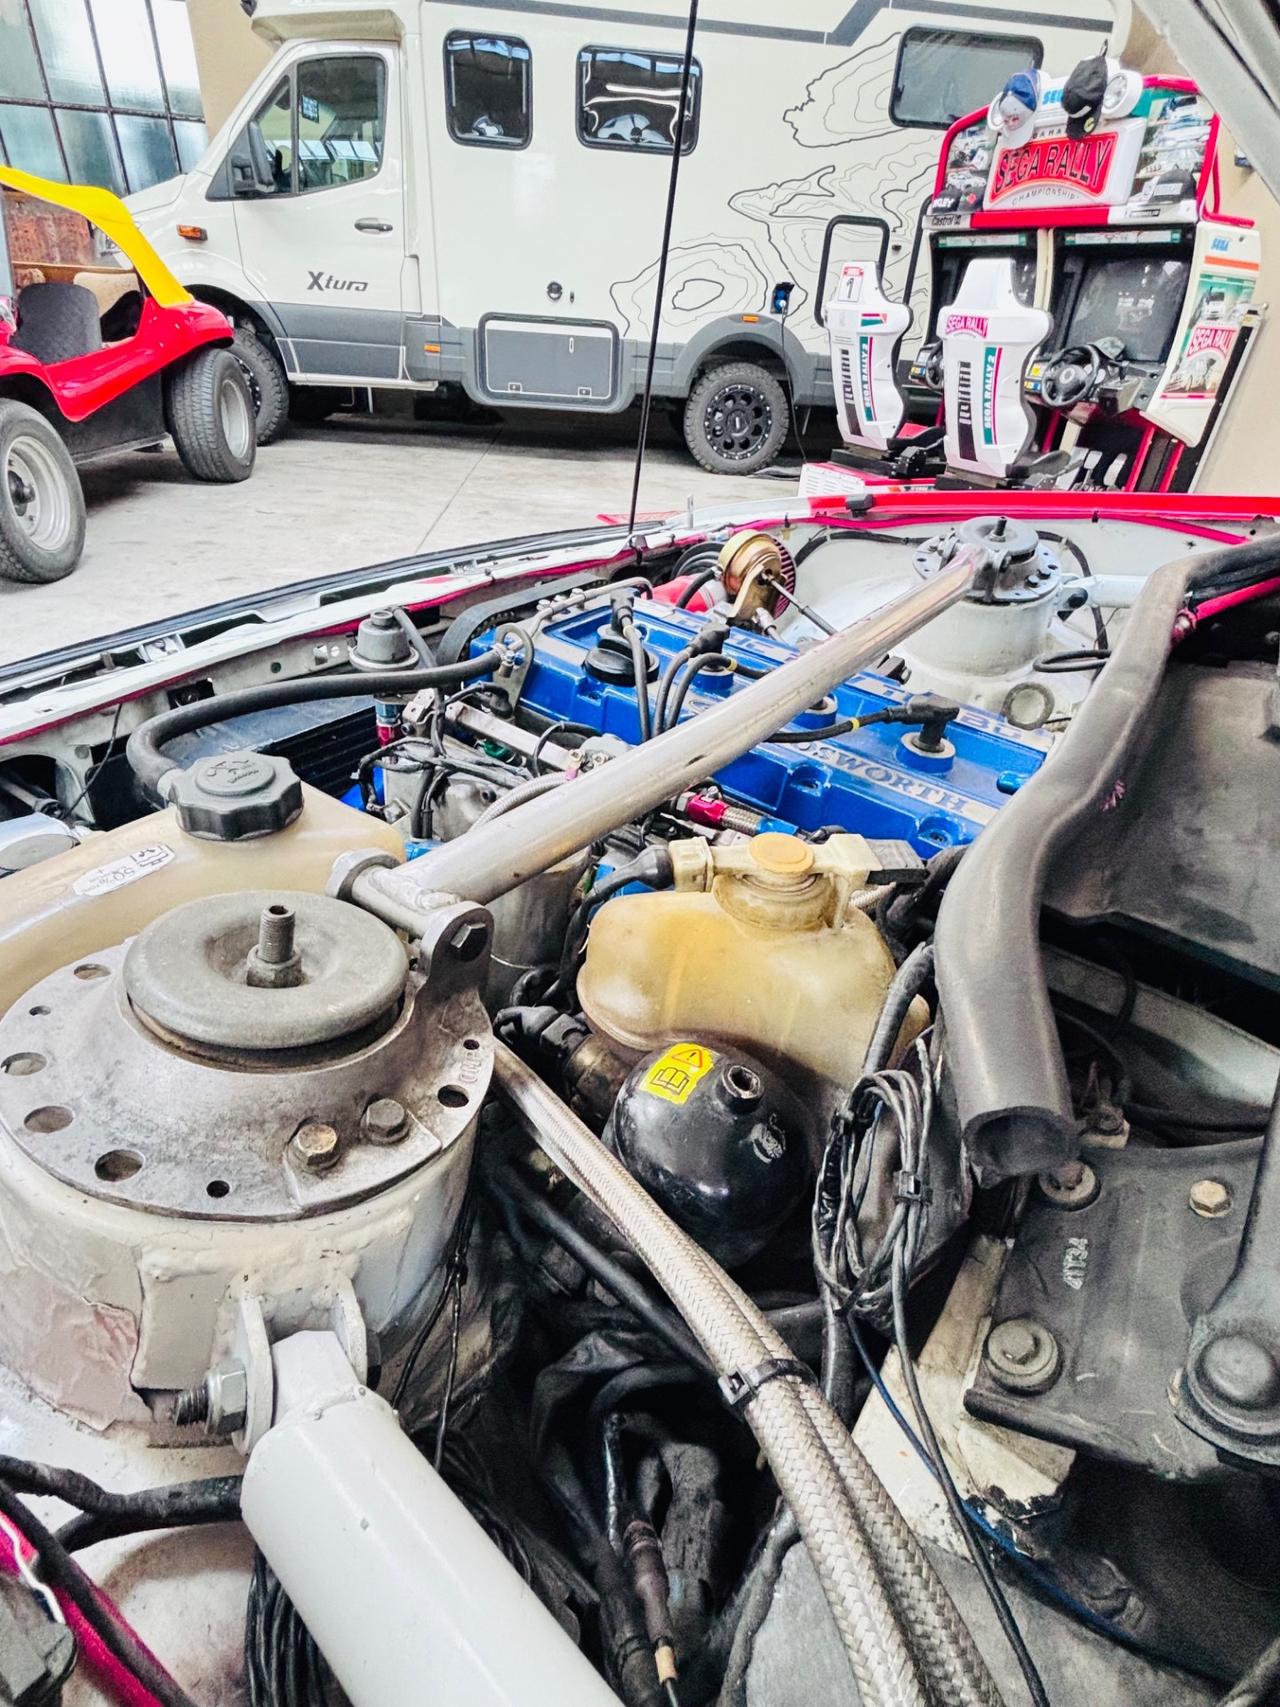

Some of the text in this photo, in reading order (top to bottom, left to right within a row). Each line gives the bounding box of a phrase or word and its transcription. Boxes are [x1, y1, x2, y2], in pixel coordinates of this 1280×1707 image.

[994, 138, 1114, 193] SEGA RALLY
[306, 270, 368, 292] Xtura
[846, 277, 855, 299] 1
[964, 316, 988, 338] RALLY
